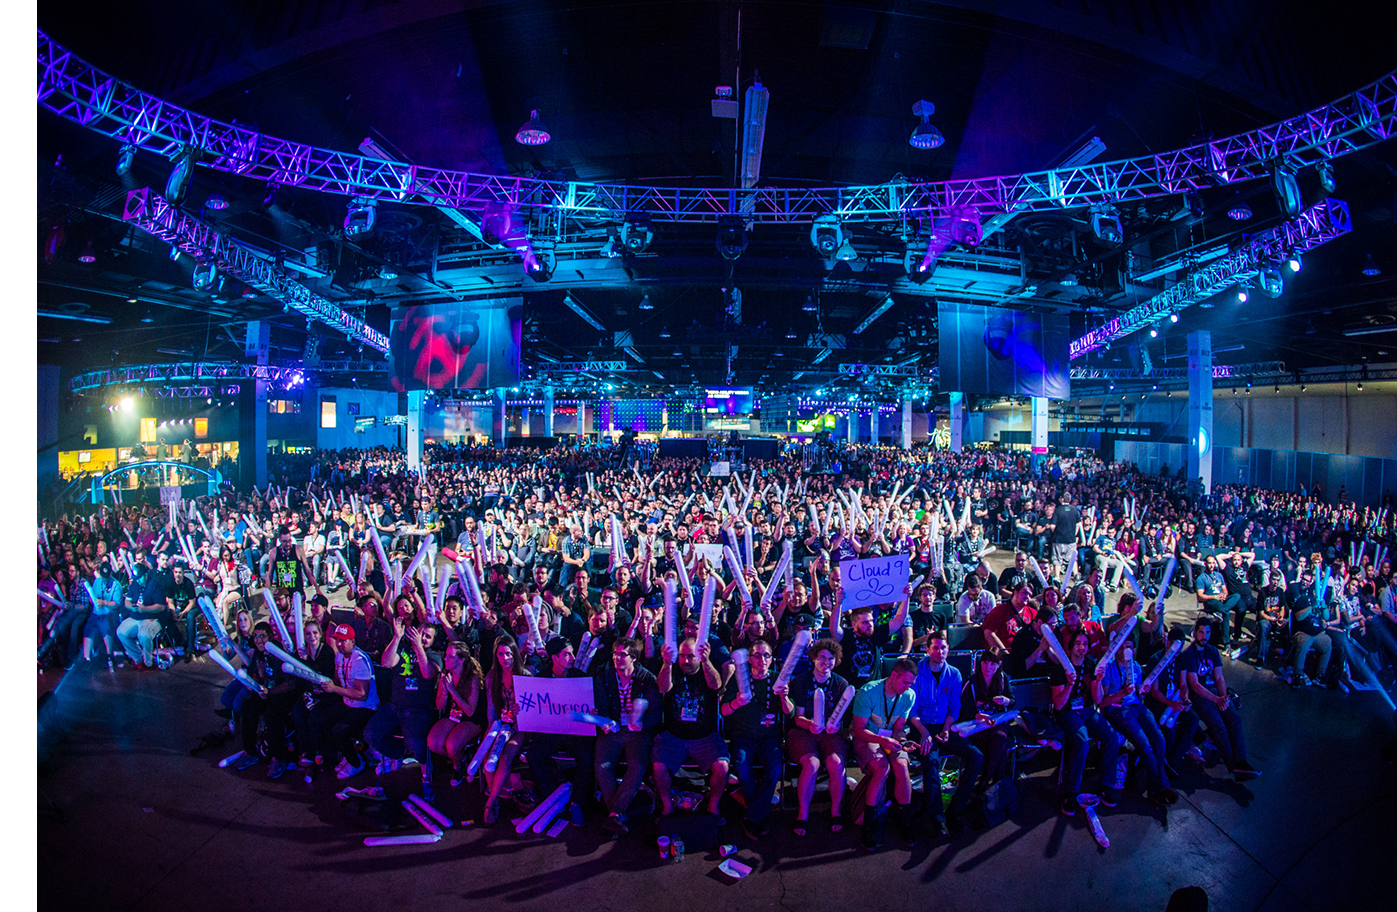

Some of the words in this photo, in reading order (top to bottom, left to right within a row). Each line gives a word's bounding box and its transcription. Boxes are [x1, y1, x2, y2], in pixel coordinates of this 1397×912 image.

[848, 562, 891, 581] Cloud
[893, 560, 904, 576] 9
[519, 691, 590, 716] #Murica
